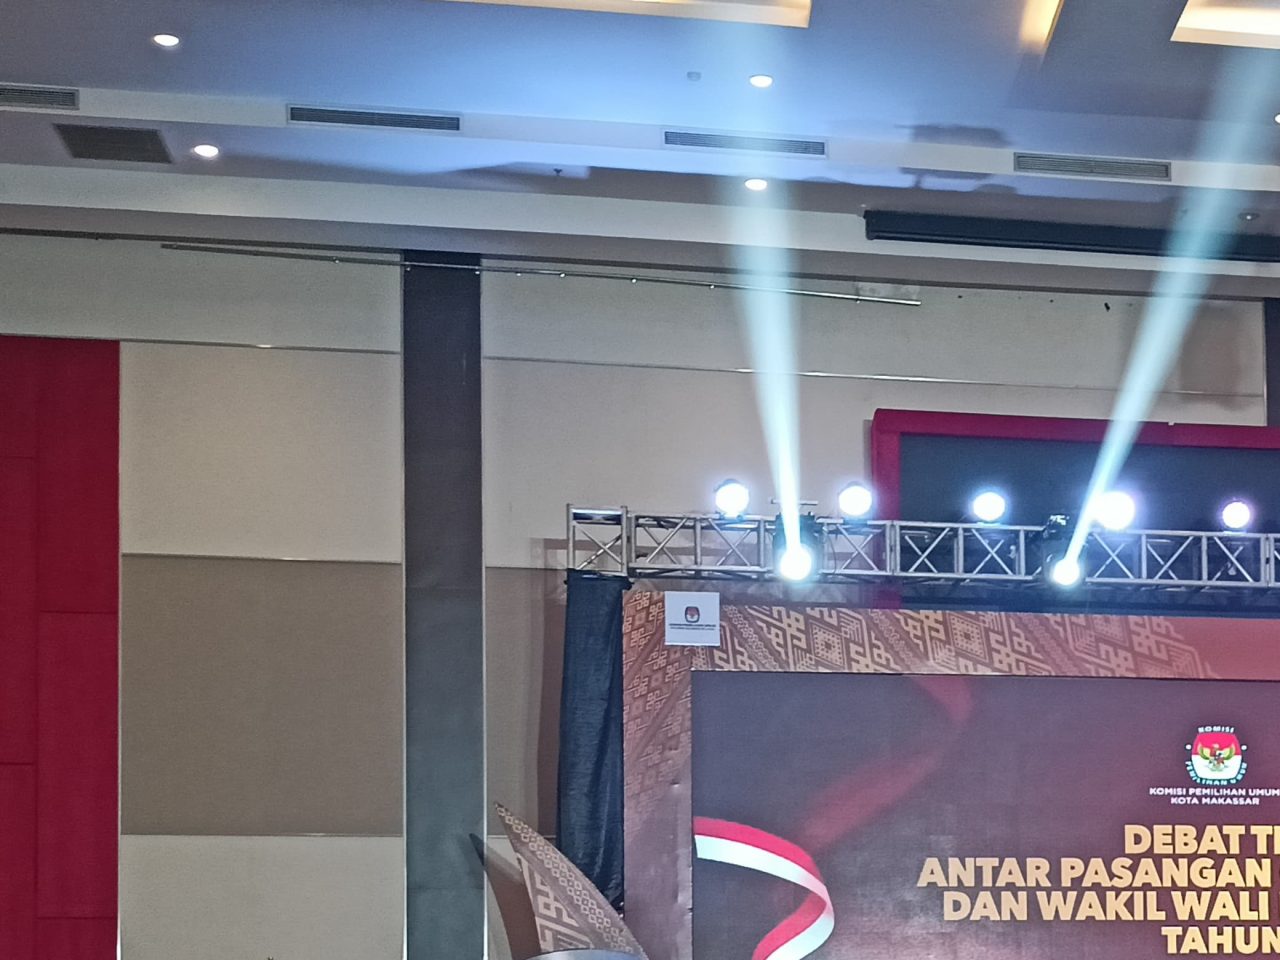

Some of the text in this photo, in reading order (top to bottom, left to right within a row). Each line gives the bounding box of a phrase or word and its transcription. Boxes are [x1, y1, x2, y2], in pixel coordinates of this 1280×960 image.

[1149, 787, 1280, 797] KOMISI PEMILIHAN UMUM
[1170, 796, 1260, 806] KOTA MAKASSAR
[1124, 824, 1246, 855] DEBAT
[916, 856, 1053, 888] ANTAR
[1060, 856, 1272, 888] PASANGAN
[943, 890, 1029, 921] DAN
[1036, 890, 1166, 921] WAKIL
[1171, 891, 1270, 921] WALI
